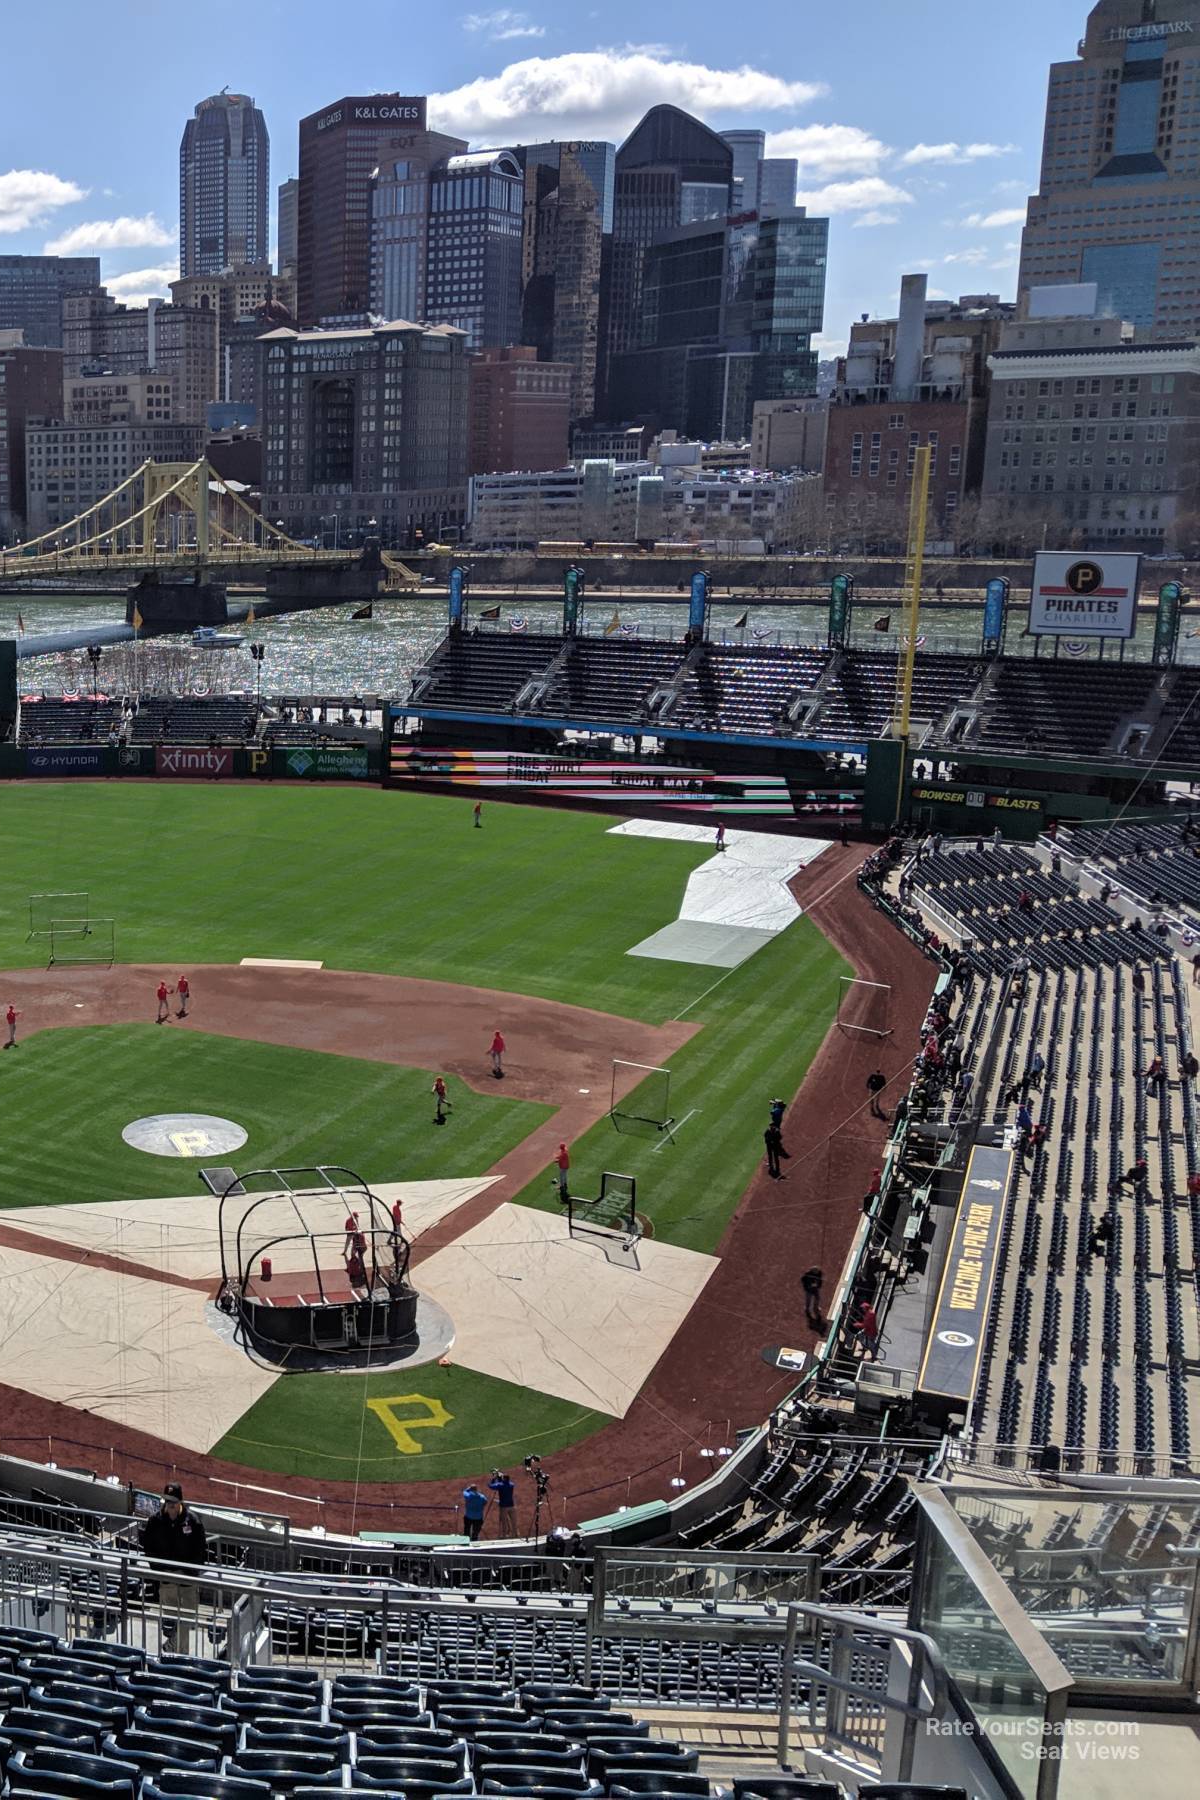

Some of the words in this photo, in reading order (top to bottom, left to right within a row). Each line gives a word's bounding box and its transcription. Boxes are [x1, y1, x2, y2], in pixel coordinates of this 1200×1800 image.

[326, 110, 342, 126] GATES
[355, 107, 377, 119] K&L
[379, 107, 419, 119] GATES
[1076, 568, 1094, 589] P
[1046, 599, 1119, 613] PIRATES
[1044, 613, 1118, 624] CHARITIES
[52, 755, 98, 766] HYUNDAI
[162, 749, 227, 773] xfinity
[251, 750, 268, 773] P
[317, 754, 368, 767] Allegheny
[919, 789, 965, 802] BOWSER
[996, 797, 1041, 810] BLASTS
[967, 1202, 994, 1228] PARK
[963, 1226, 989, 1249] PNC
[962, 1247, 983, 1259] TO
[949, 1258, 984, 1310] WELCOME
[366, 1393, 455, 1455] P
